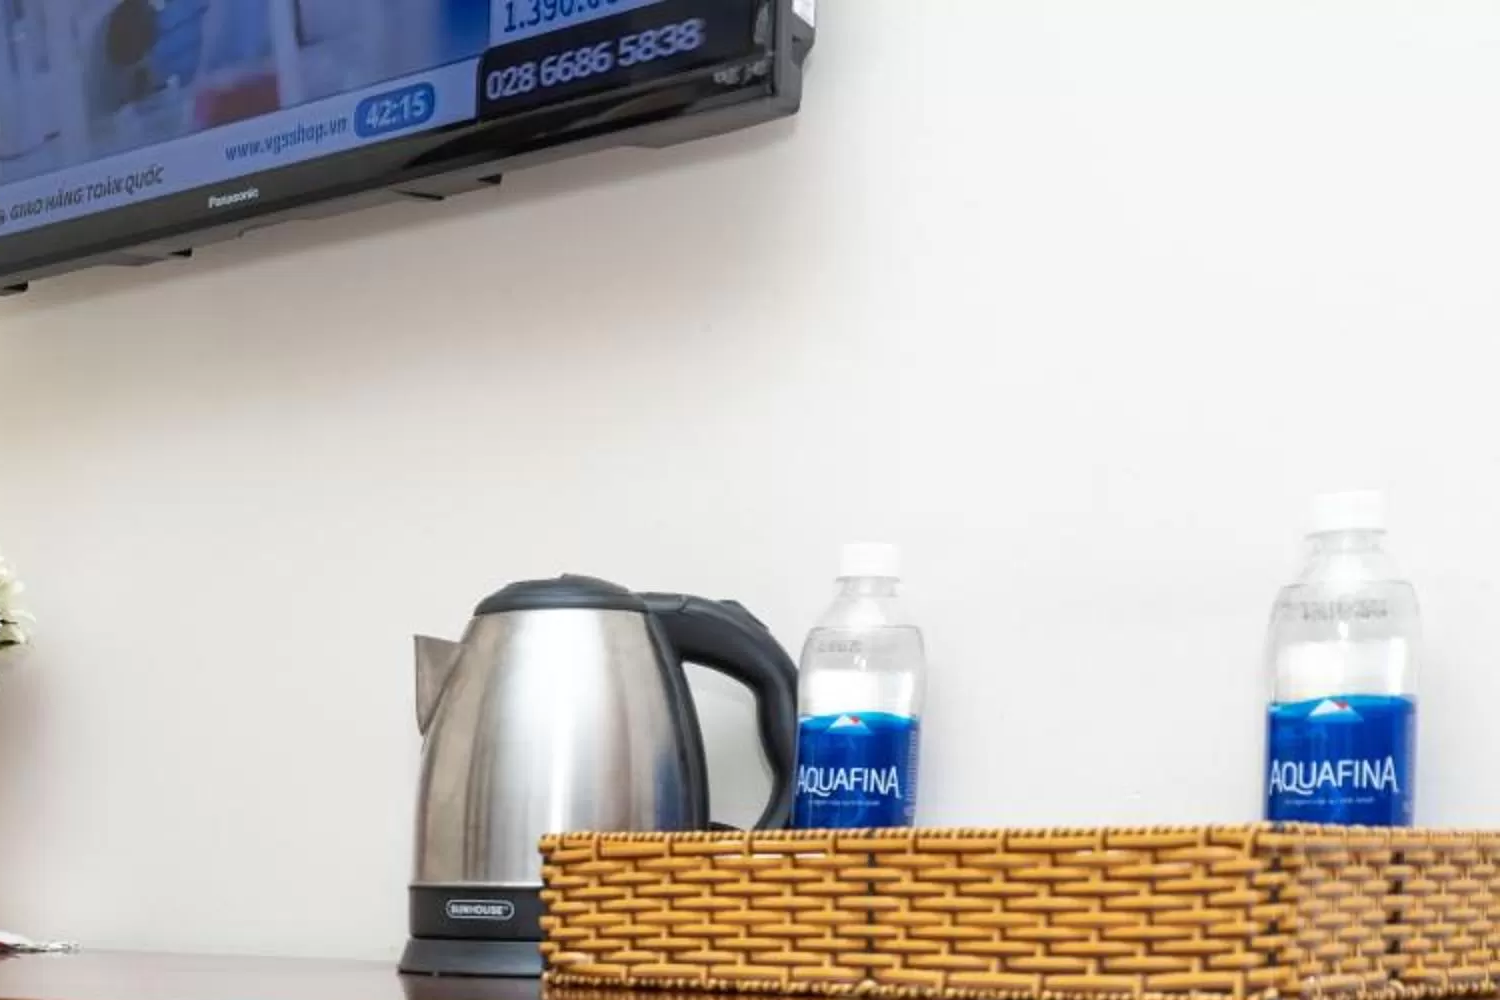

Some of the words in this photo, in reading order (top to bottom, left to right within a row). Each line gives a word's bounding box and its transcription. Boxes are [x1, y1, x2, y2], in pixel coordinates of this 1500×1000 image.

[503, 0, 619, 33] 1.390.
[486, 61, 538, 100] 028
[540, 41, 614, 88] 6686
[617, 18, 706, 67] 5838
[365, 89, 426, 129] 42:15
[224, 115, 349, 161] www.vgsshop.vn
[208, 186, 260, 209] Panasonic
[796, 764, 903, 800] AQUAFINA
[1269, 755, 1400, 797] AQUAFINA
